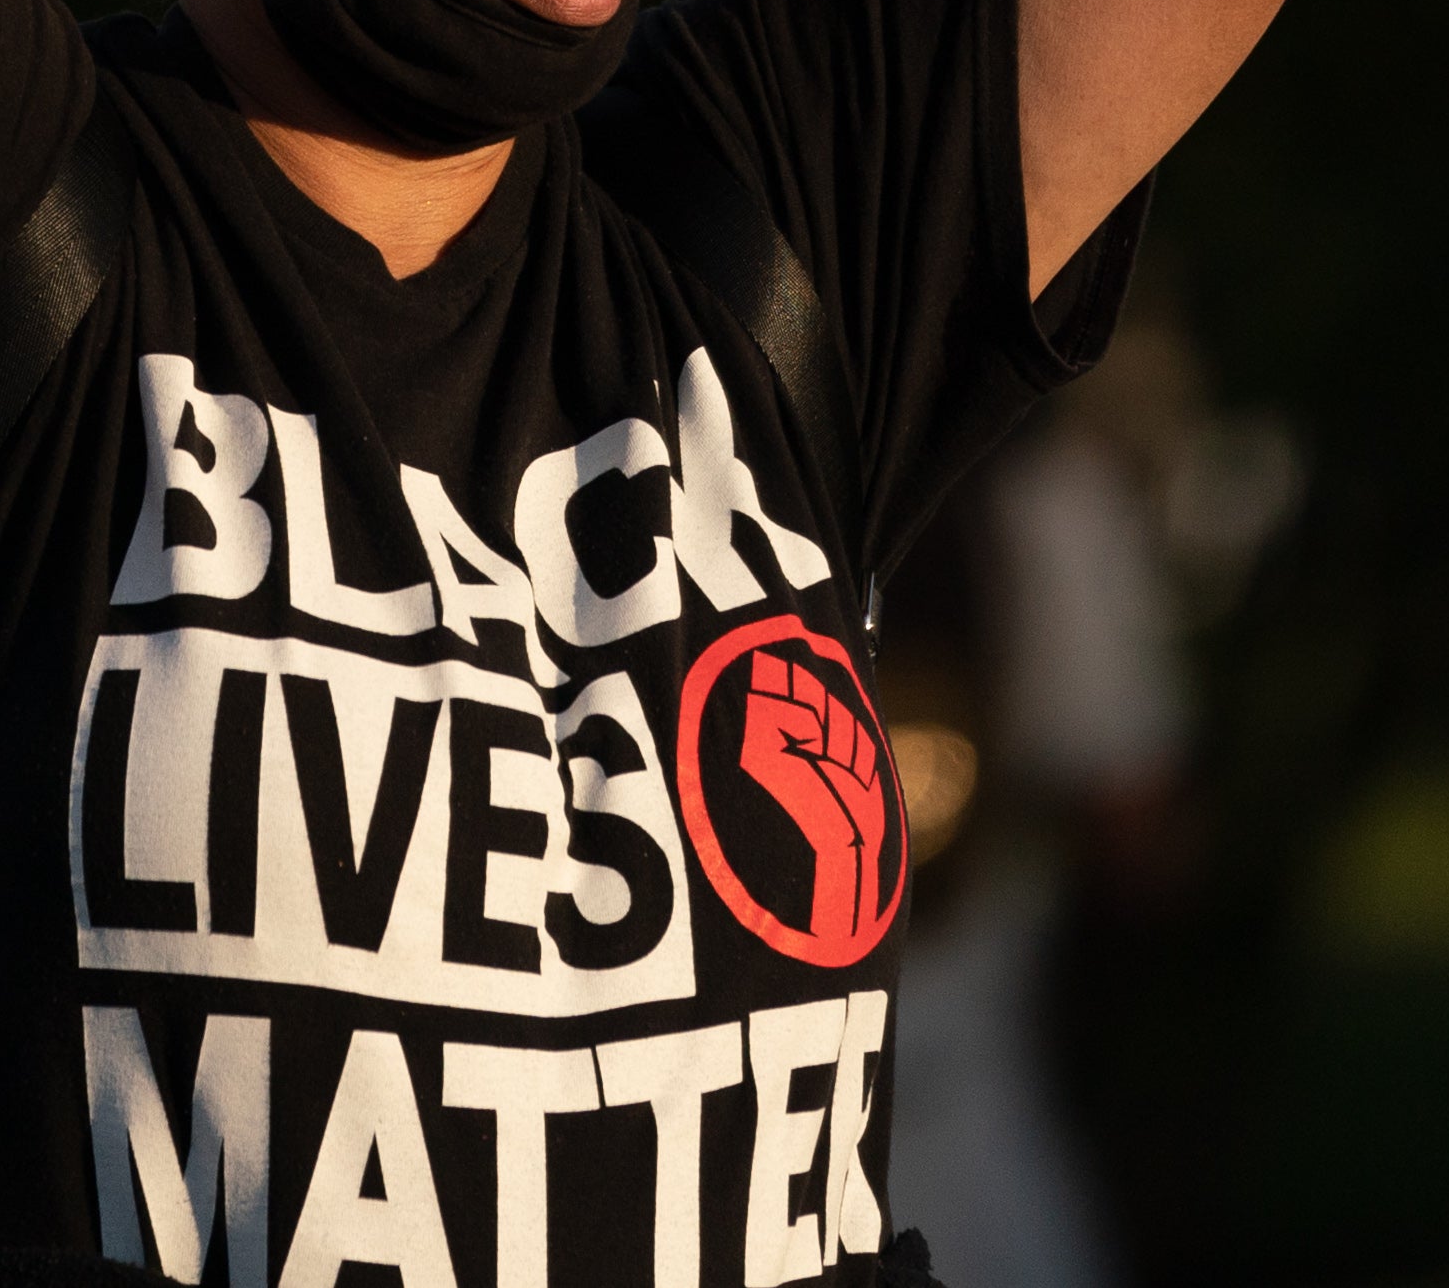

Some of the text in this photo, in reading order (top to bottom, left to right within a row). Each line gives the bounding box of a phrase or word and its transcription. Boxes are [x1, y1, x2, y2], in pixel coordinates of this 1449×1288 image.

[111, 345, 831, 688] BLACK
[89, 668, 676, 975] LIVES
[82, 989, 889, 1288] MATTER
